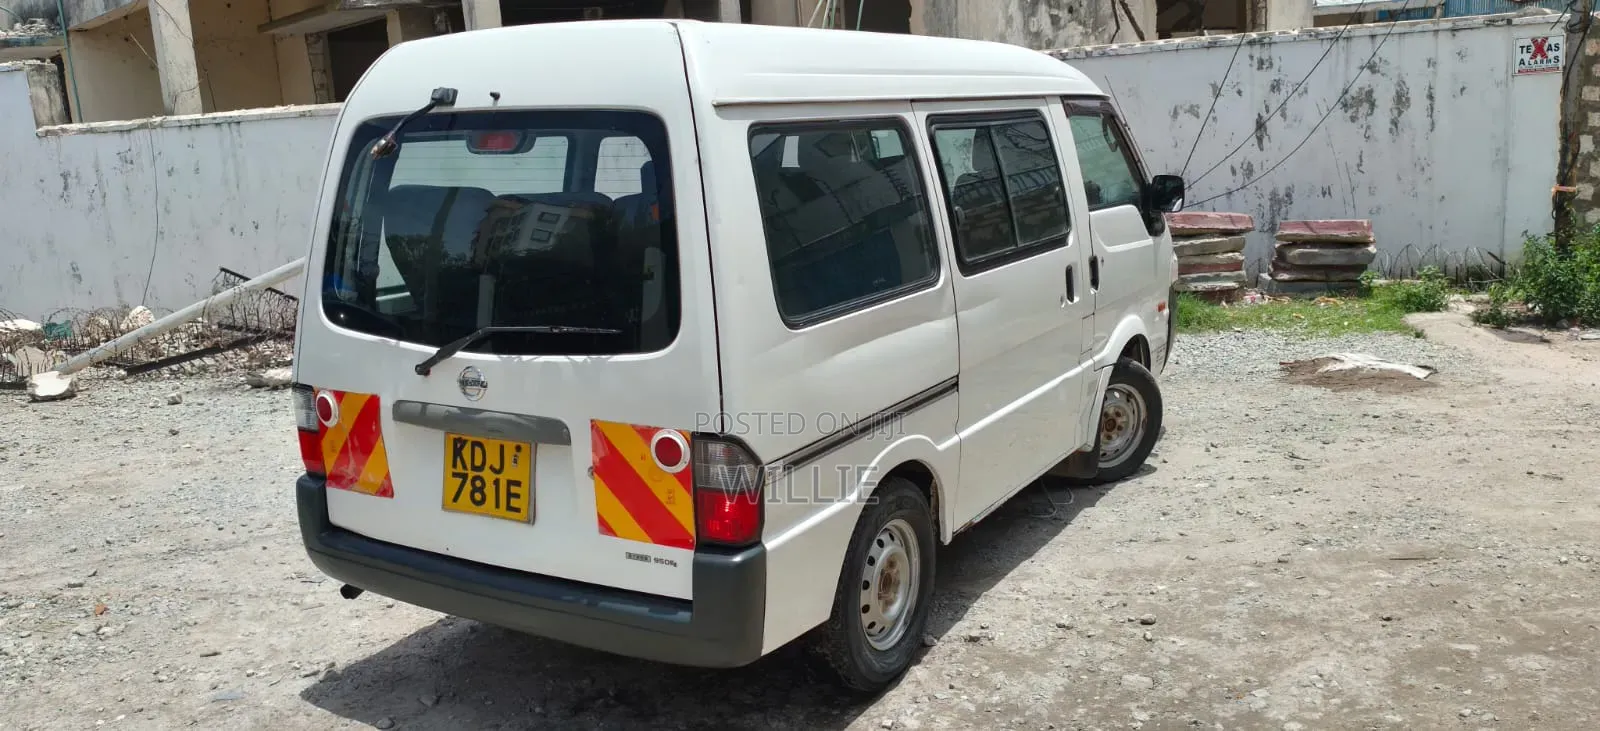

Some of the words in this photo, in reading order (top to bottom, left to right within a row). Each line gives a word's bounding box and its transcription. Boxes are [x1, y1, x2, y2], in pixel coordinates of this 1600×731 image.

[1519, 36, 1560, 60] TEXAS
[1519, 55, 1560, 66] ALARMS
[452, 437, 505, 475] KDJ
[452, 471, 522, 514] 781E
